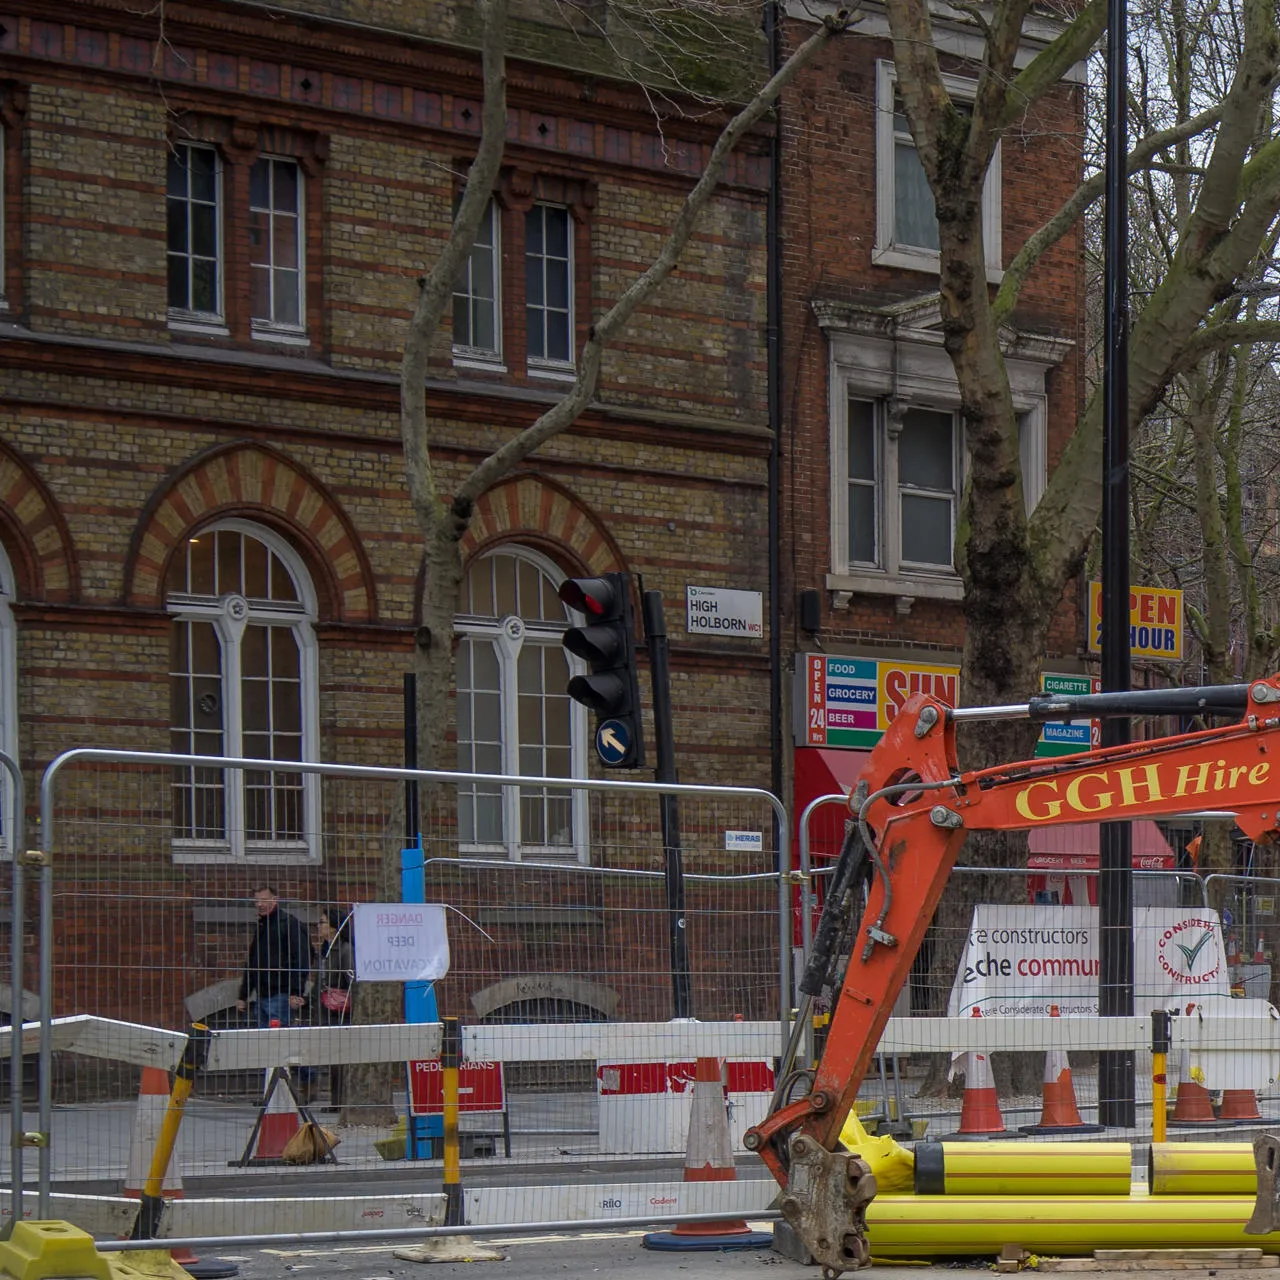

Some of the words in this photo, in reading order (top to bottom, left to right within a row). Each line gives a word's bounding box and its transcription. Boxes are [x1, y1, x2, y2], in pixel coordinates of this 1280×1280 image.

[690, 600, 718, 612] HIGH
[690, 616, 746, 631] HOLBORN
[828, 663, 856, 674] FOOD
[1046, 680, 1088, 692] CIGARETTE
[828, 688, 875, 700] GROCERY
[810, 708, 824, 729] 24
[828, 713, 855, 724] BEER
[812, 732, 823, 742] Hrs
[1046, 728, 1084, 738] MAGAZINE
[1015, 763, 1168, 821] GGH
[1171, 759, 1272, 799] Hire
[992, 929, 1088, 945] constructors
[1000, 1004, 1044, 1014] Considerate
[649, 1197, 677, 1205] Cadent
